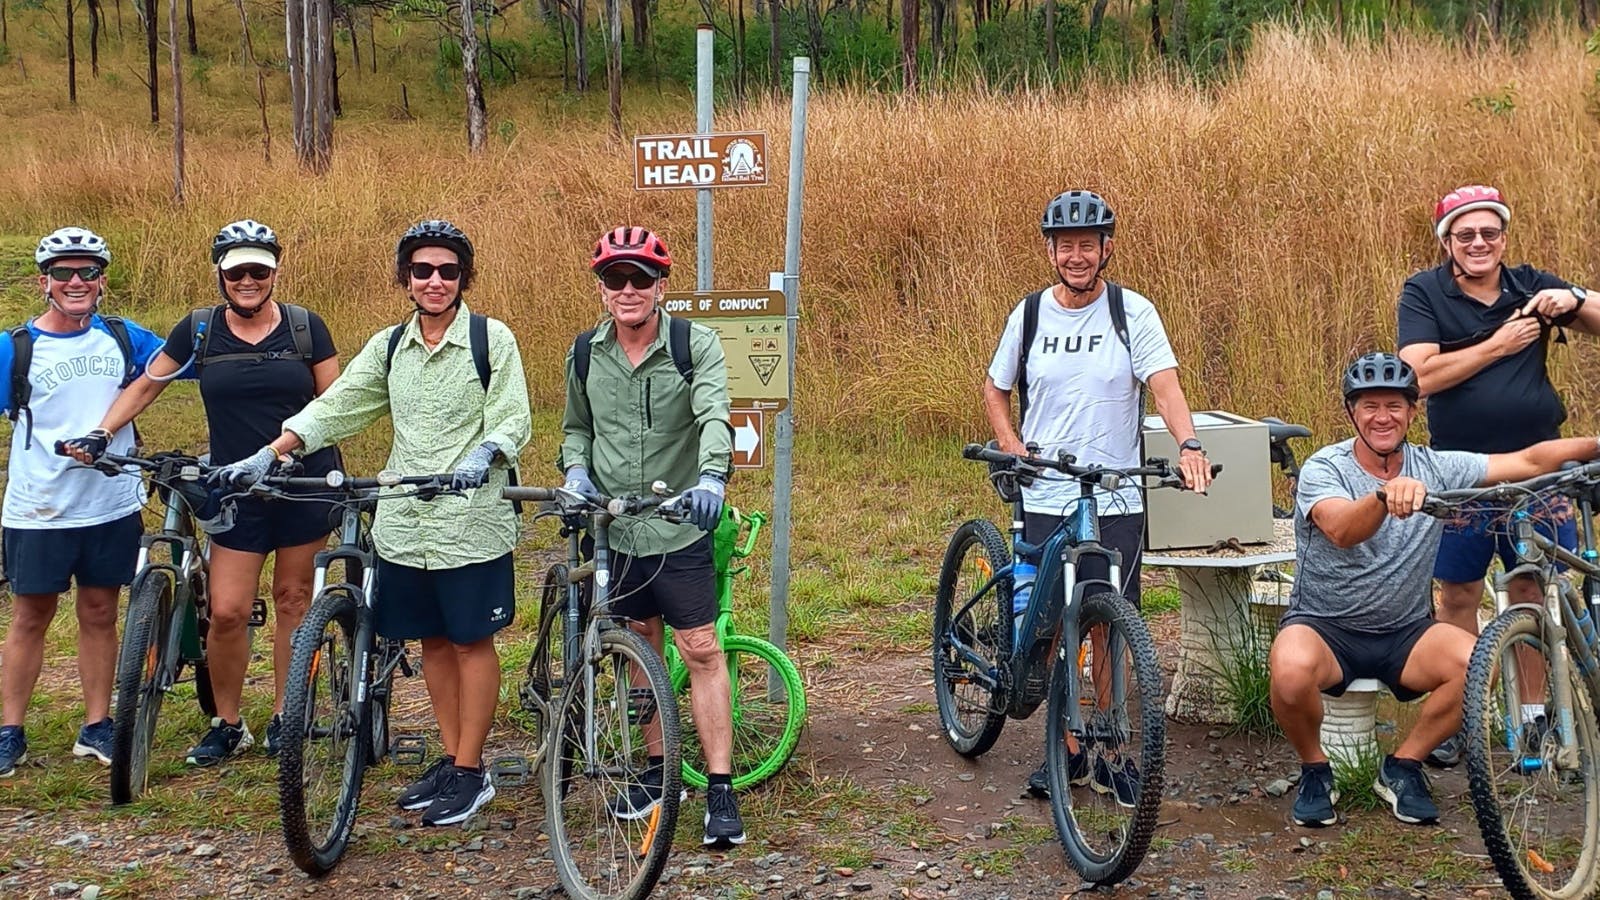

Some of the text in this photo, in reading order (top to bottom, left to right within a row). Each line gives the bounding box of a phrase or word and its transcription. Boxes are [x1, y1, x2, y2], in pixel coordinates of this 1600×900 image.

[639, 139, 718, 160] TRAIL
[643, 164, 716, 184] HEAD
[665, 298, 769, 312] CODE OF CONDUCT
[1042, 334, 1103, 354] HUF
[36, 355, 120, 390] TOUCH
